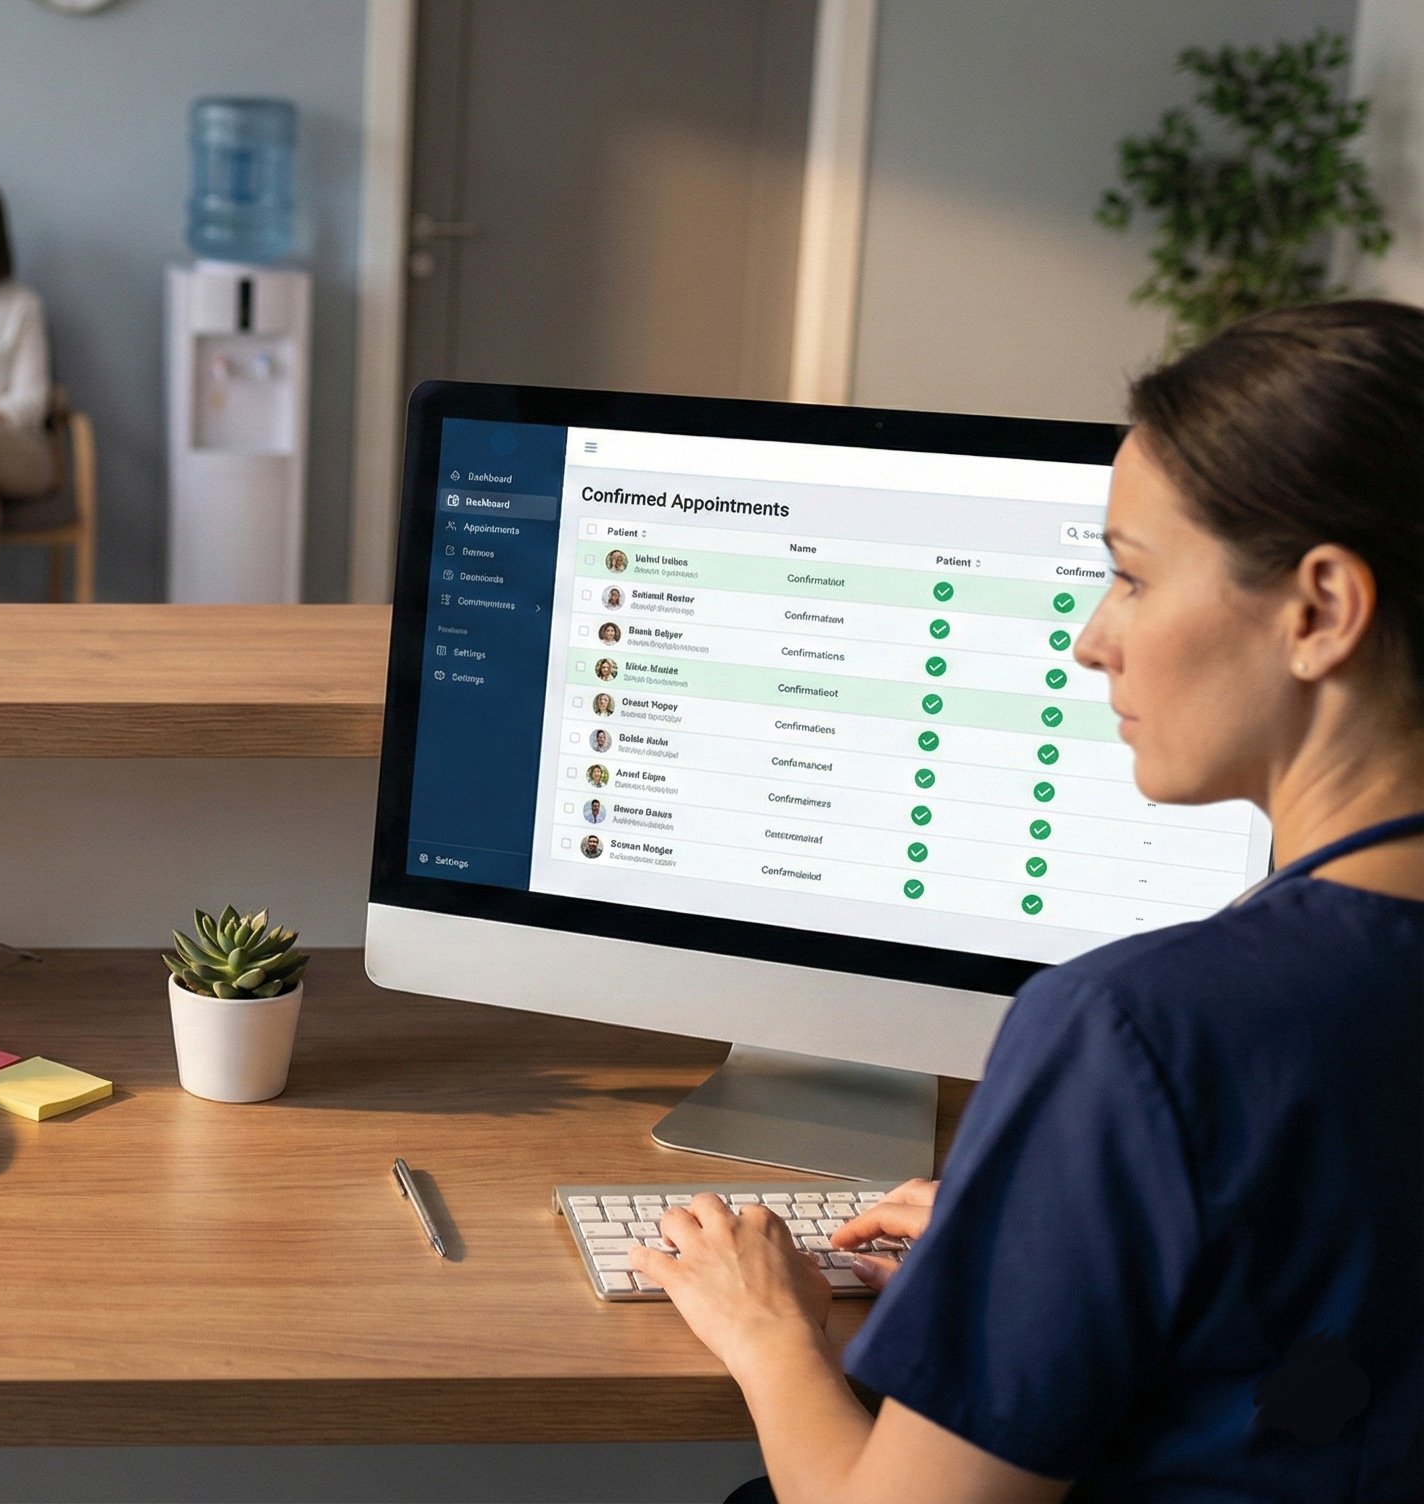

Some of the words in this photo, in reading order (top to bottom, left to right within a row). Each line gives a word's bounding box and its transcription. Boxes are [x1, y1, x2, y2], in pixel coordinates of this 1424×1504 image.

[581, 486, 667, 508] Confirmed
[670, 494, 790, 517] Appointments
[463, 522, 520, 535] Appointments
[607, 527, 638, 538] Patient
[789, 543, 817, 554] Name
[935, 555, 972, 568] Patient
